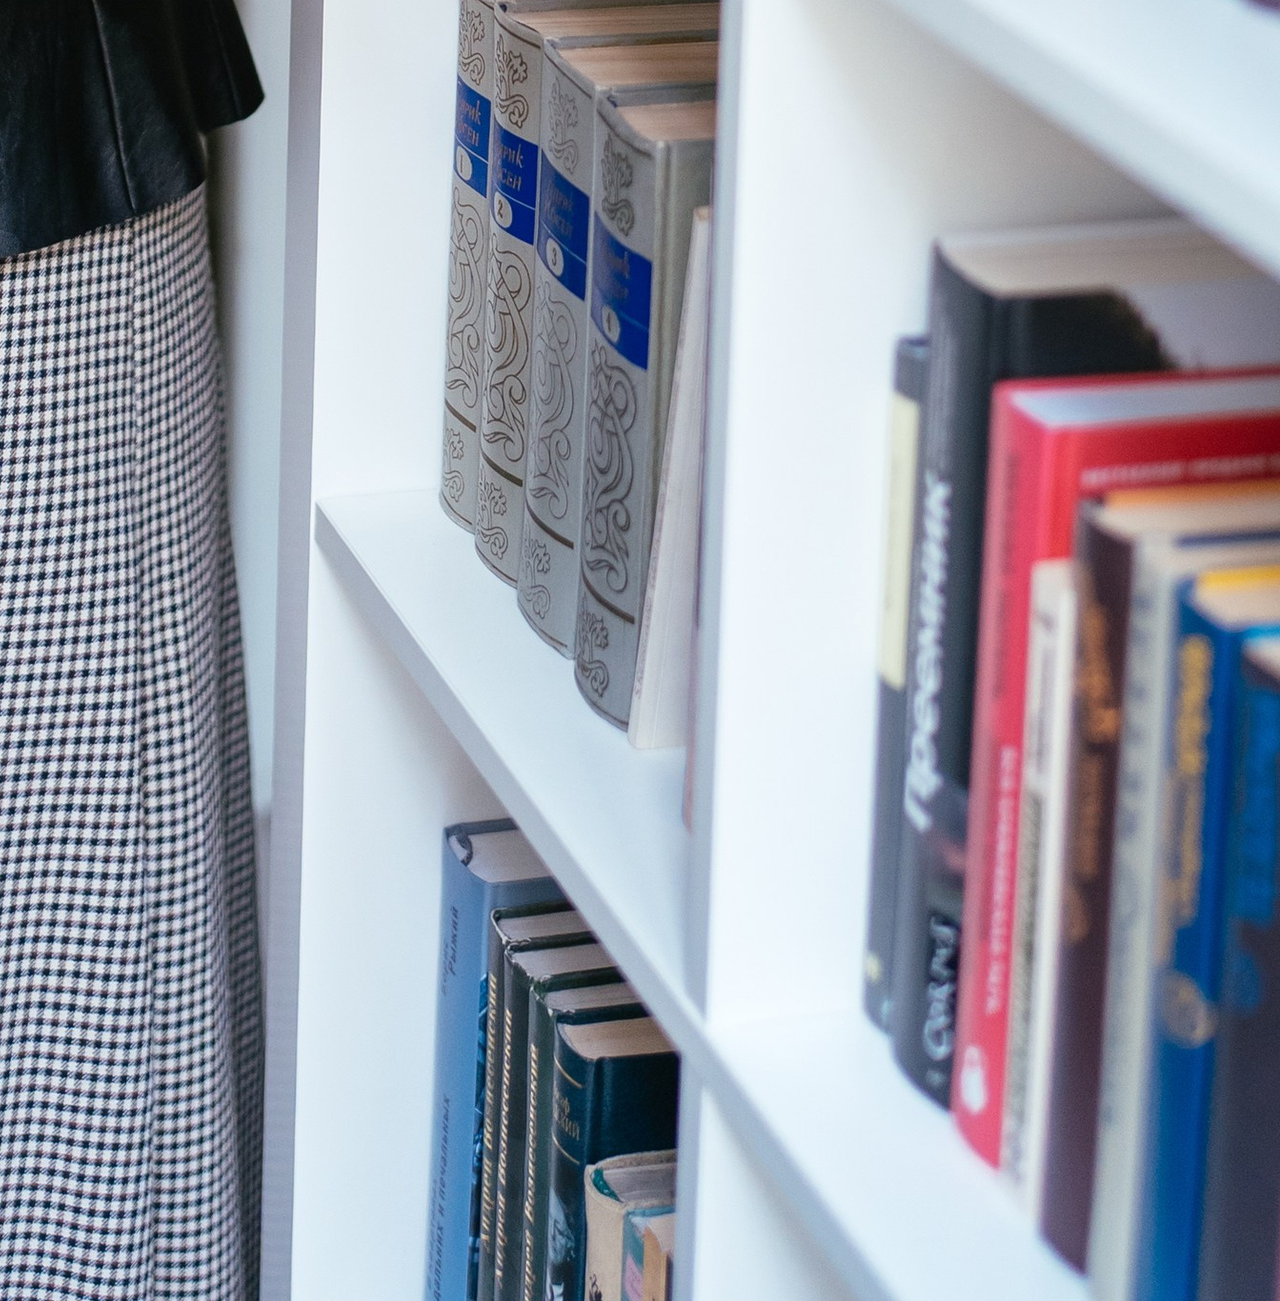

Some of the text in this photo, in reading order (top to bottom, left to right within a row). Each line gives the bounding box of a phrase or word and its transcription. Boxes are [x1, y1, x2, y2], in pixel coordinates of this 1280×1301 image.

[447, 905, 459, 977] Рыжий
[482, 971, 498, 1151] Вонесенский
[497, 1008, 513, 1187] Вознесенский
[437, 1095, 451, 1201] печальных
[524, 1042, 540, 1301] ндрей Вознесенский
[432, 1221, 445, 1301] дальних
